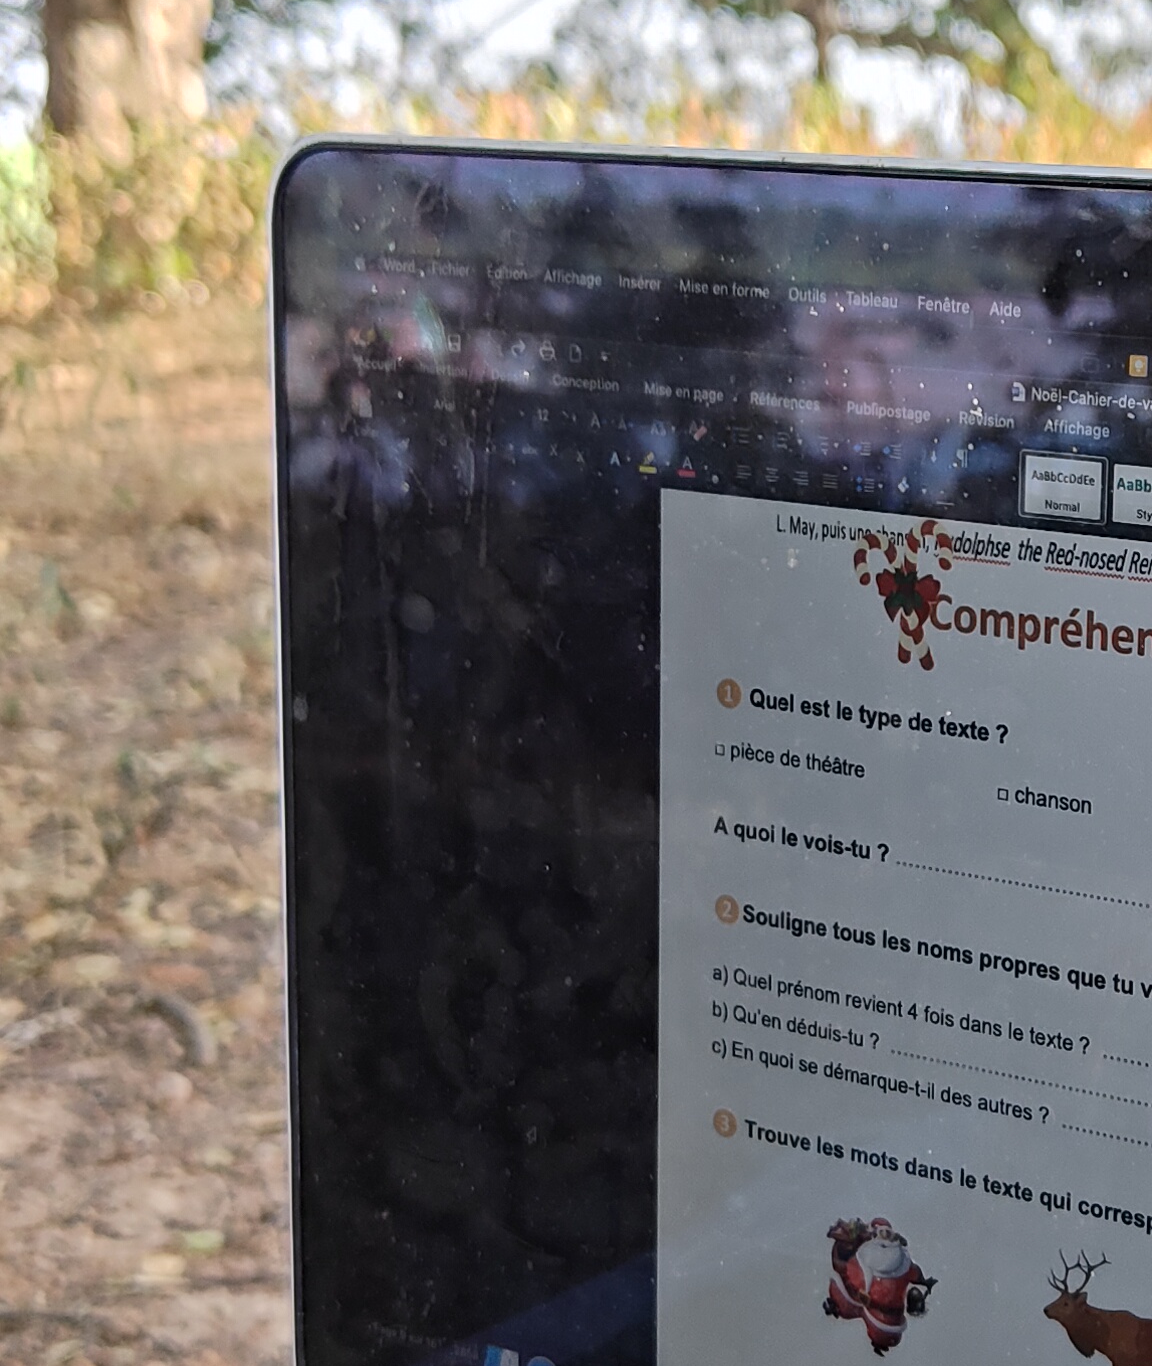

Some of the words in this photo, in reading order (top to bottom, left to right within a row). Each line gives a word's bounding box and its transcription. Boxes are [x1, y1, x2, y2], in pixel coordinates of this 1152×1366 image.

[543, 270, 602, 287] Affichage
[679, 279, 708, 295] Mise
[713, 282, 728, 296] en
[732, 283, 770, 299] forme
[788, 288, 827, 304] Outils
[846, 292, 898, 309] Tableau
[918, 297, 970, 314] Fenêtre
[989, 301, 1021, 318] Aide
[552, 374, 619, 391] Conception
[644, 381, 671, 398] Mise
[676, 386, 690, 400] en
[694, 387, 723, 403] page
[750, 391, 820, 411] Références
[847, 401, 931, 422] Publipostage
[1044, 419, 1110, 439] Affichage
[1031, 470, 1095, 487] AaBbCcDdEe
[1045, 500, 1081, 514] Normal
[776, 514, 787, 533] L.
[790, 516, 818, 539] May,
[822, 520, 846, 541] puis
[1018, 539, 1042, 562] the
[749, 688, 795, 713] Quel
[800, 698, 831, 717] est
[836, 702, 853, 721] le
[859, 705, 902, 730] type
[908, 712, 933, 732] de
[938, 717, 990, 742] texte
[730, 742, 775, 764] pièce
[780, 749, 801, 767] de
[806, 753, 866, 778] théâtre
[1014, 787, 1092, 814] chanson
[714, 817, 729, 835] A
[733, 824, 776, 846] quoi
[781, 827, 798, 847] le
[803, 832, 871, 859] vois-tu
[742, 905, 827, 937] Souligne
[833, 922, 876, 946] tous
[882, 930, 911, 953] les
[917, 939, 974, 965] noms
[979, 951, 1060, 981] propres
[1067, 967, 1106, 991] que
[1112, 974, 1134, 996] tu
[712, 964, 729, 986] a)
[733, 968, 773, 992] Quel
[777, 978, 840, 1006] prénom
[846, 993, 903, 1018] revient
[908, 1003, 918, 1020] 4
[924, 1006, 954, 1028] fois
[959, 1013, 1002, 1037] dans
[1008, 1022, 1024, 1041] le
[1029, 1027, 1074, 1053] texte
[712, 1000, 728, 1023] b)
[732, 1004, 782, 1032] Qu'en
[786, 1016, 864, 1048] déduis-tu
[711, 1039, 728, 1059] c)
[732, 1040, 754, 1062] En
[759, 1048, 794, 1070] quoi
[798, 1057, 818, 1074] se
[823, 1059, 935, 1101] démarque-t-il
[940, 1085, 972, 1108] des
[978, 1095, 1033, 1121] autres
[744, 1119, 812, 1151] Trouve
[817, 1137, 844, 1159] les
[851, 1147, 899, 1171] mots
[905, 1157, 953, 1183] dans
[960, 1168, 977, 1188] le
[983, 1174, 1033, 1202] texte
[1039, 1191, 1072, 1214] qui
